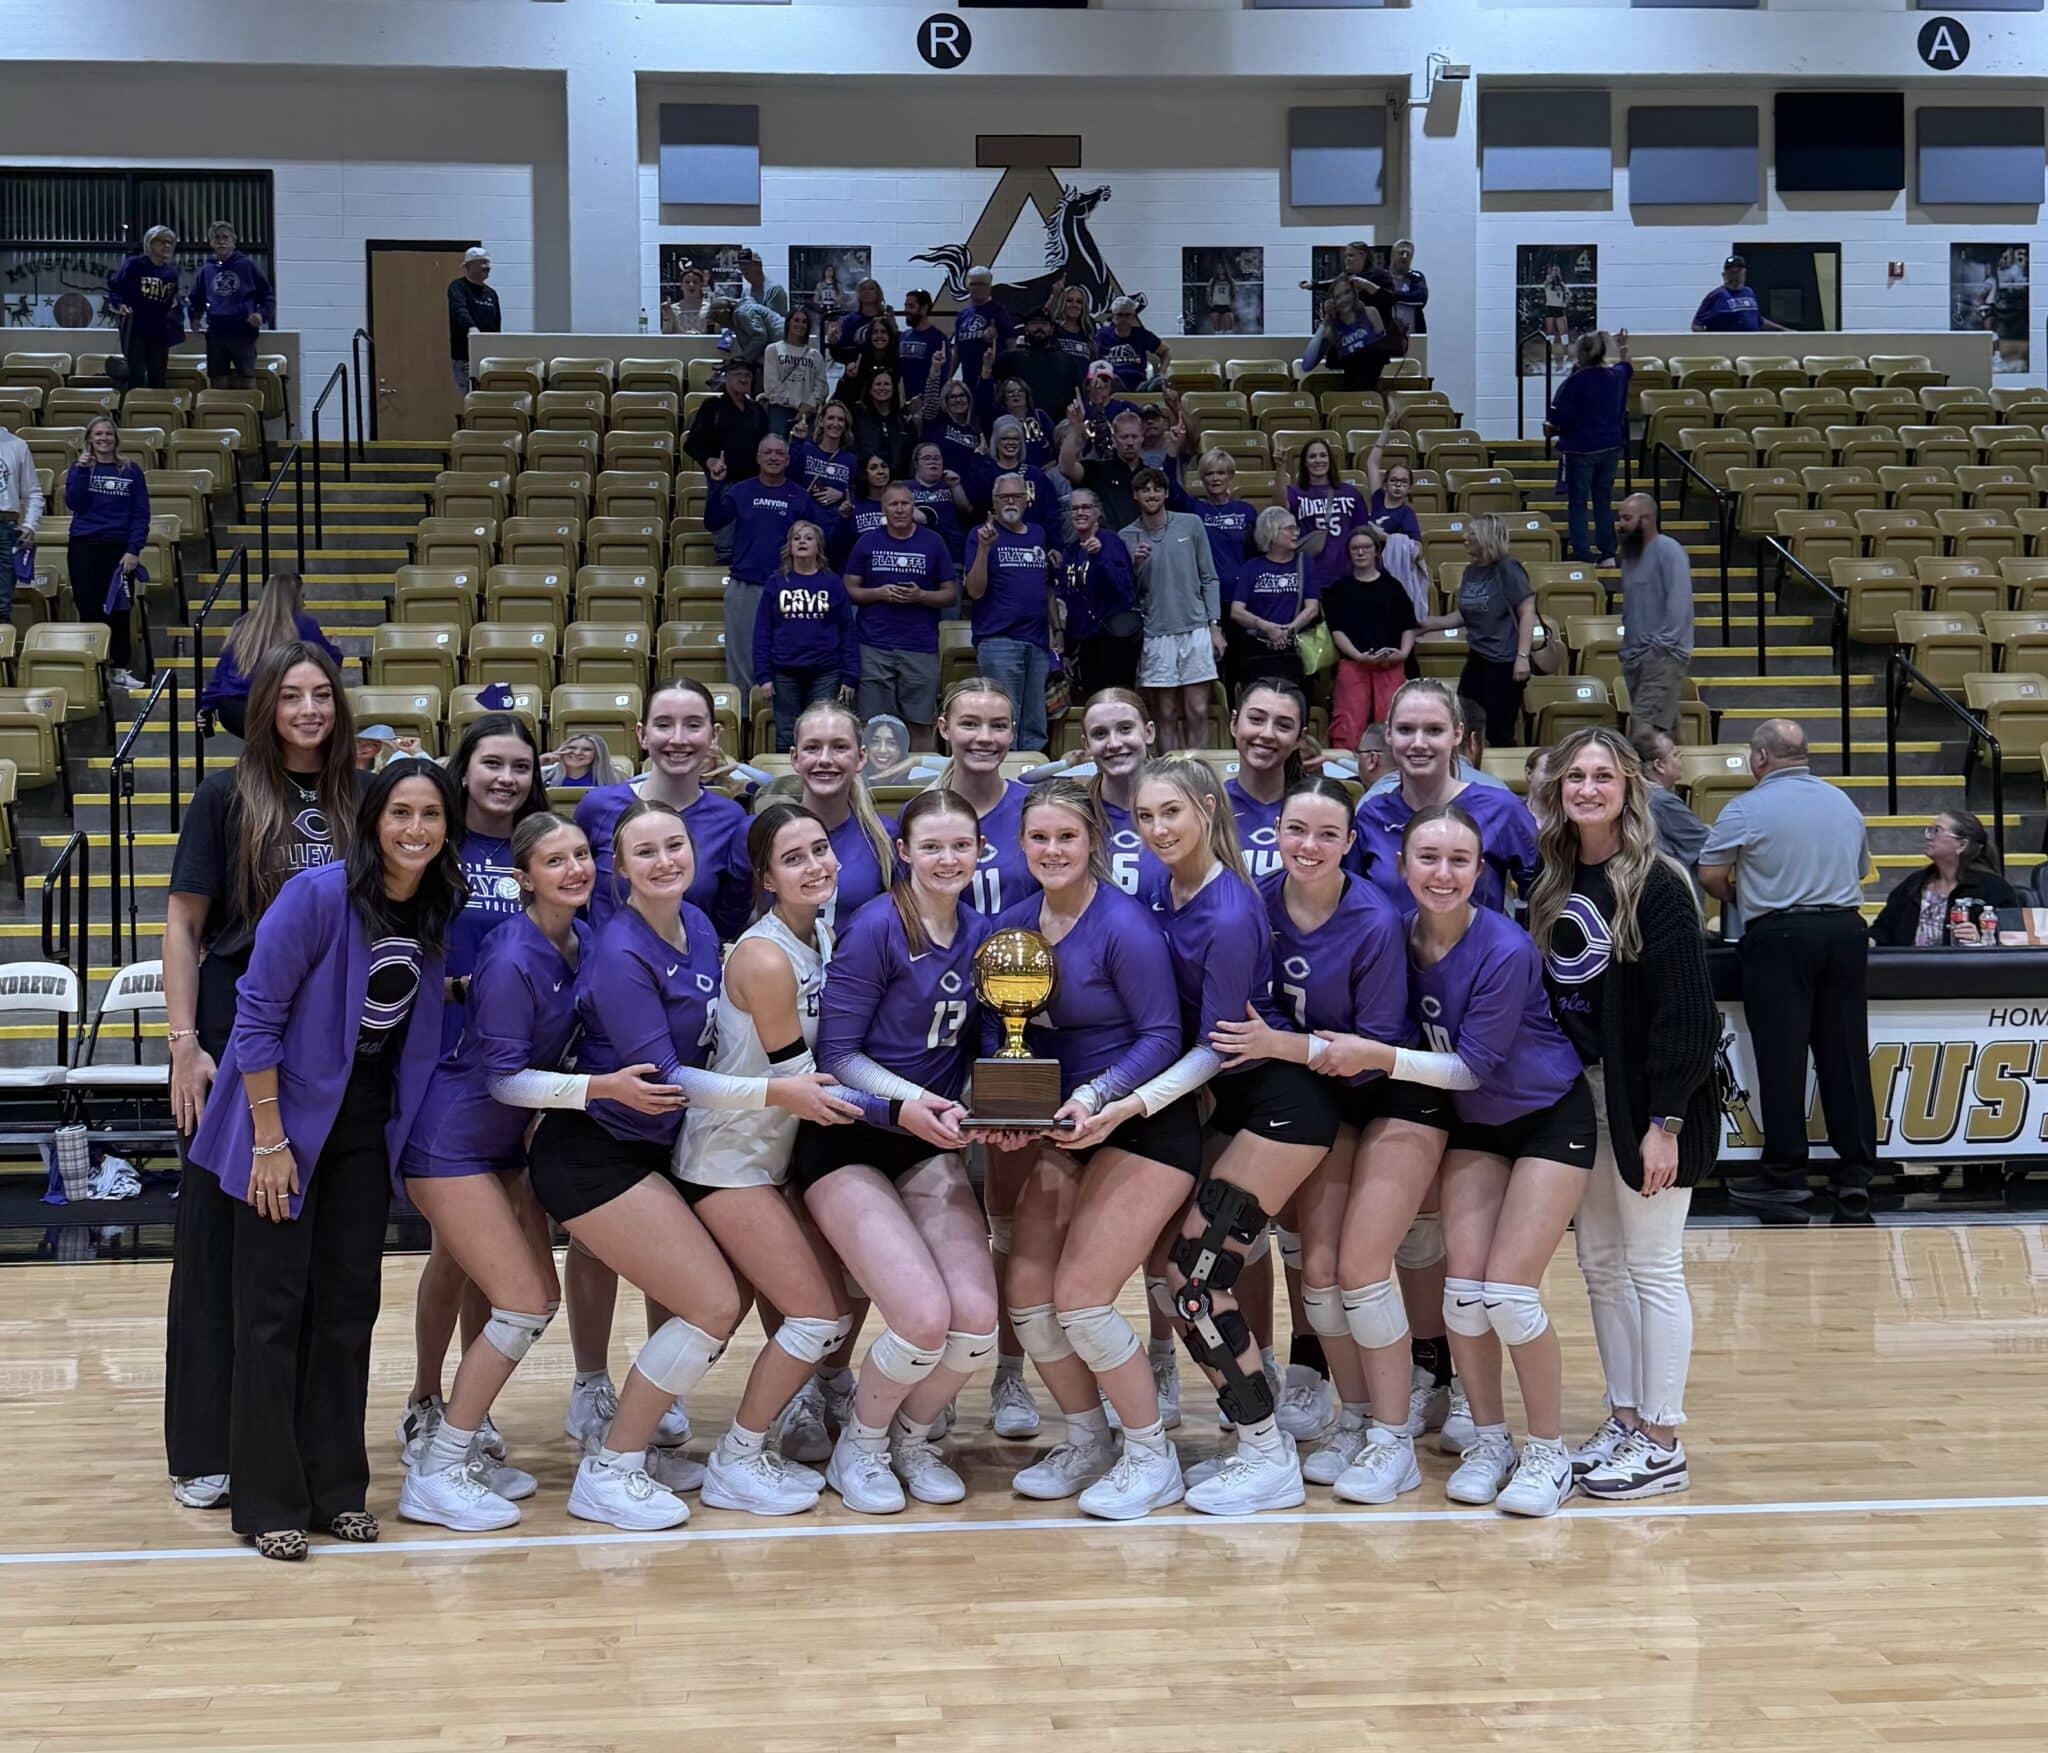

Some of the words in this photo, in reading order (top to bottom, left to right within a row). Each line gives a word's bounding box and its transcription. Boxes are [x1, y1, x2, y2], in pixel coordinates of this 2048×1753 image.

[930, 22, 962, 58] R
[1928, 25, 1960, 61] A
[753, 498, 788, 509] CANYON
[1111, 853, 1139, 895] 6
[0, 975, 67, 997] NDREWS
[118, 973, 165, 996] ANDR
[927, 1000, 968, 1049] 13
[1283, 983, 1306, 1031] 7
[1988, 1007, 2048, 1027] HOM
